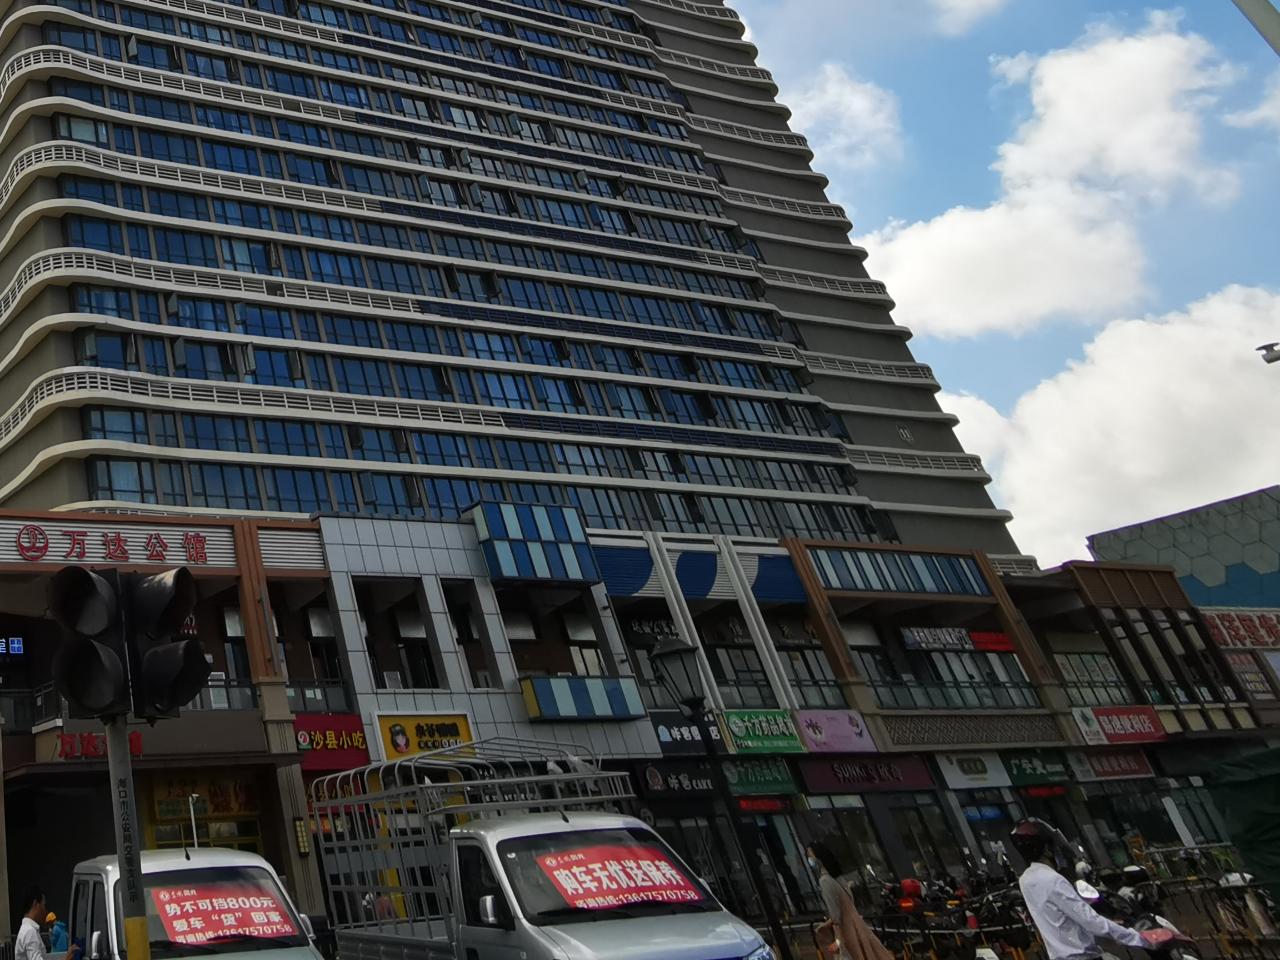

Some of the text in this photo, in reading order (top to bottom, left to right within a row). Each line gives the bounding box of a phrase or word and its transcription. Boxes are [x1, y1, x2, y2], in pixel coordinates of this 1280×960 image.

[62, 530, 208, 565] 万达公馆
[310, 729, 366, 750] 沙县小吃
[553, 859, 685, 896] 购车无忧送保养
[165, 896, 277, 917] 势不可挡800元
